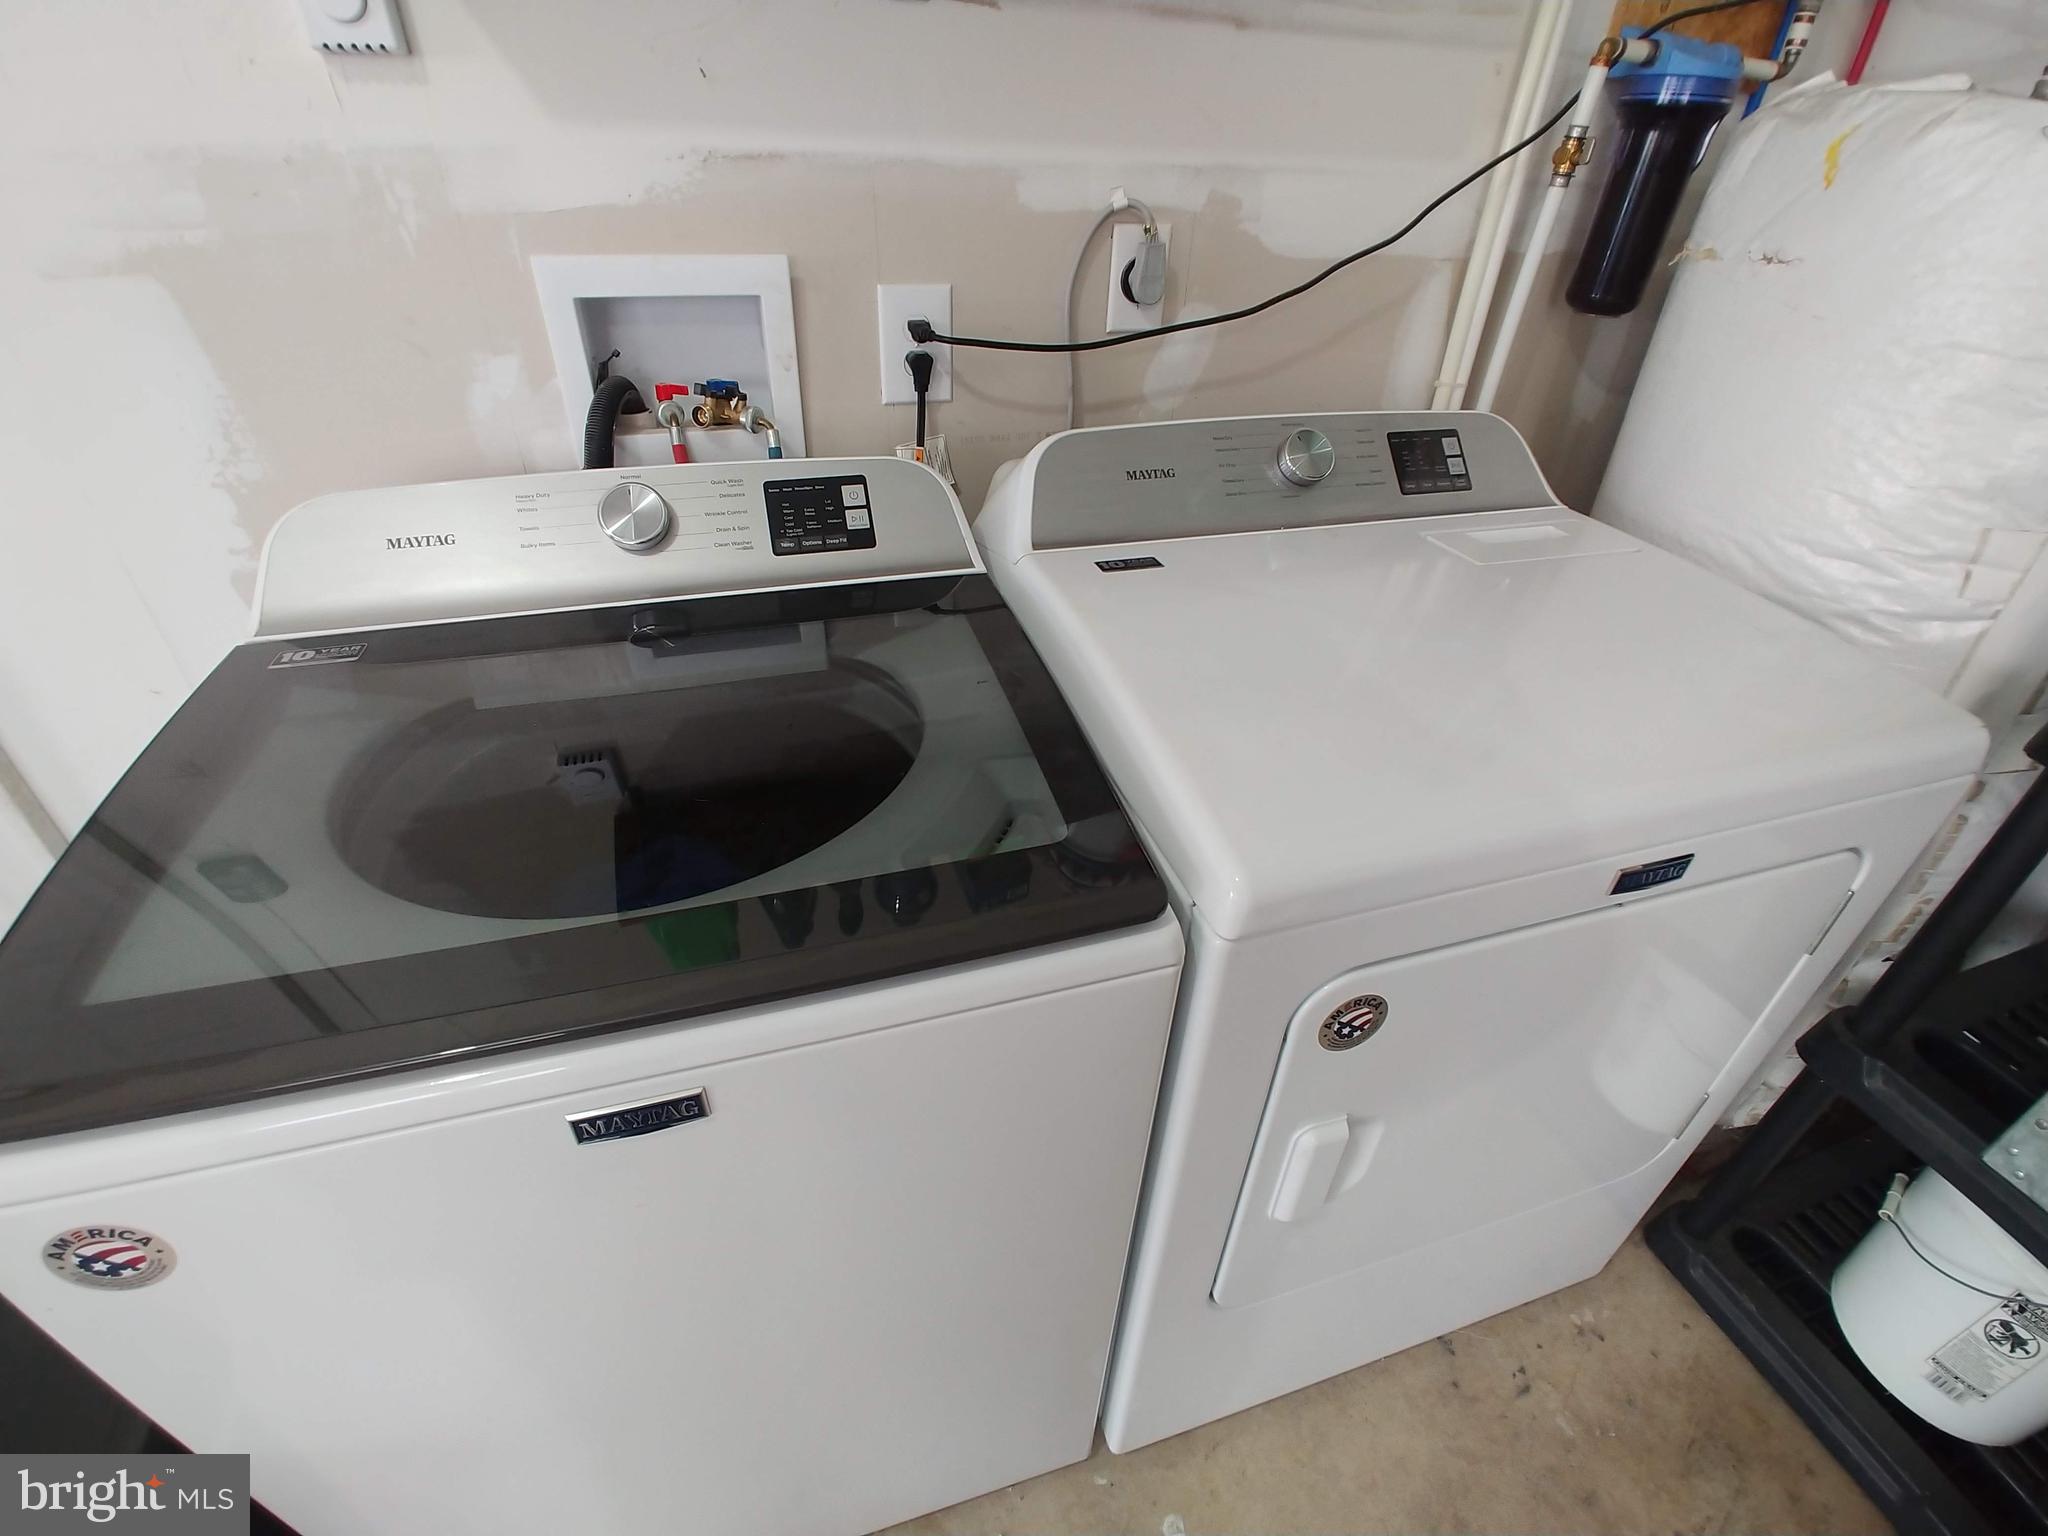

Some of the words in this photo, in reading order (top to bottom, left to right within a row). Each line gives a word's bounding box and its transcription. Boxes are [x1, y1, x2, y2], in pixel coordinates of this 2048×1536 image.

[1125, 467, 1177, 481] MAYTAG
[385, 533, 456, 550] MAYTAG
[279, 650, 317, 664] 10
[1323, 996, 1384, 1031] AMERICA
[578, 1100, 699, 1139] MAYTAG
[47, 1227, 153, 1262] AMERICA
